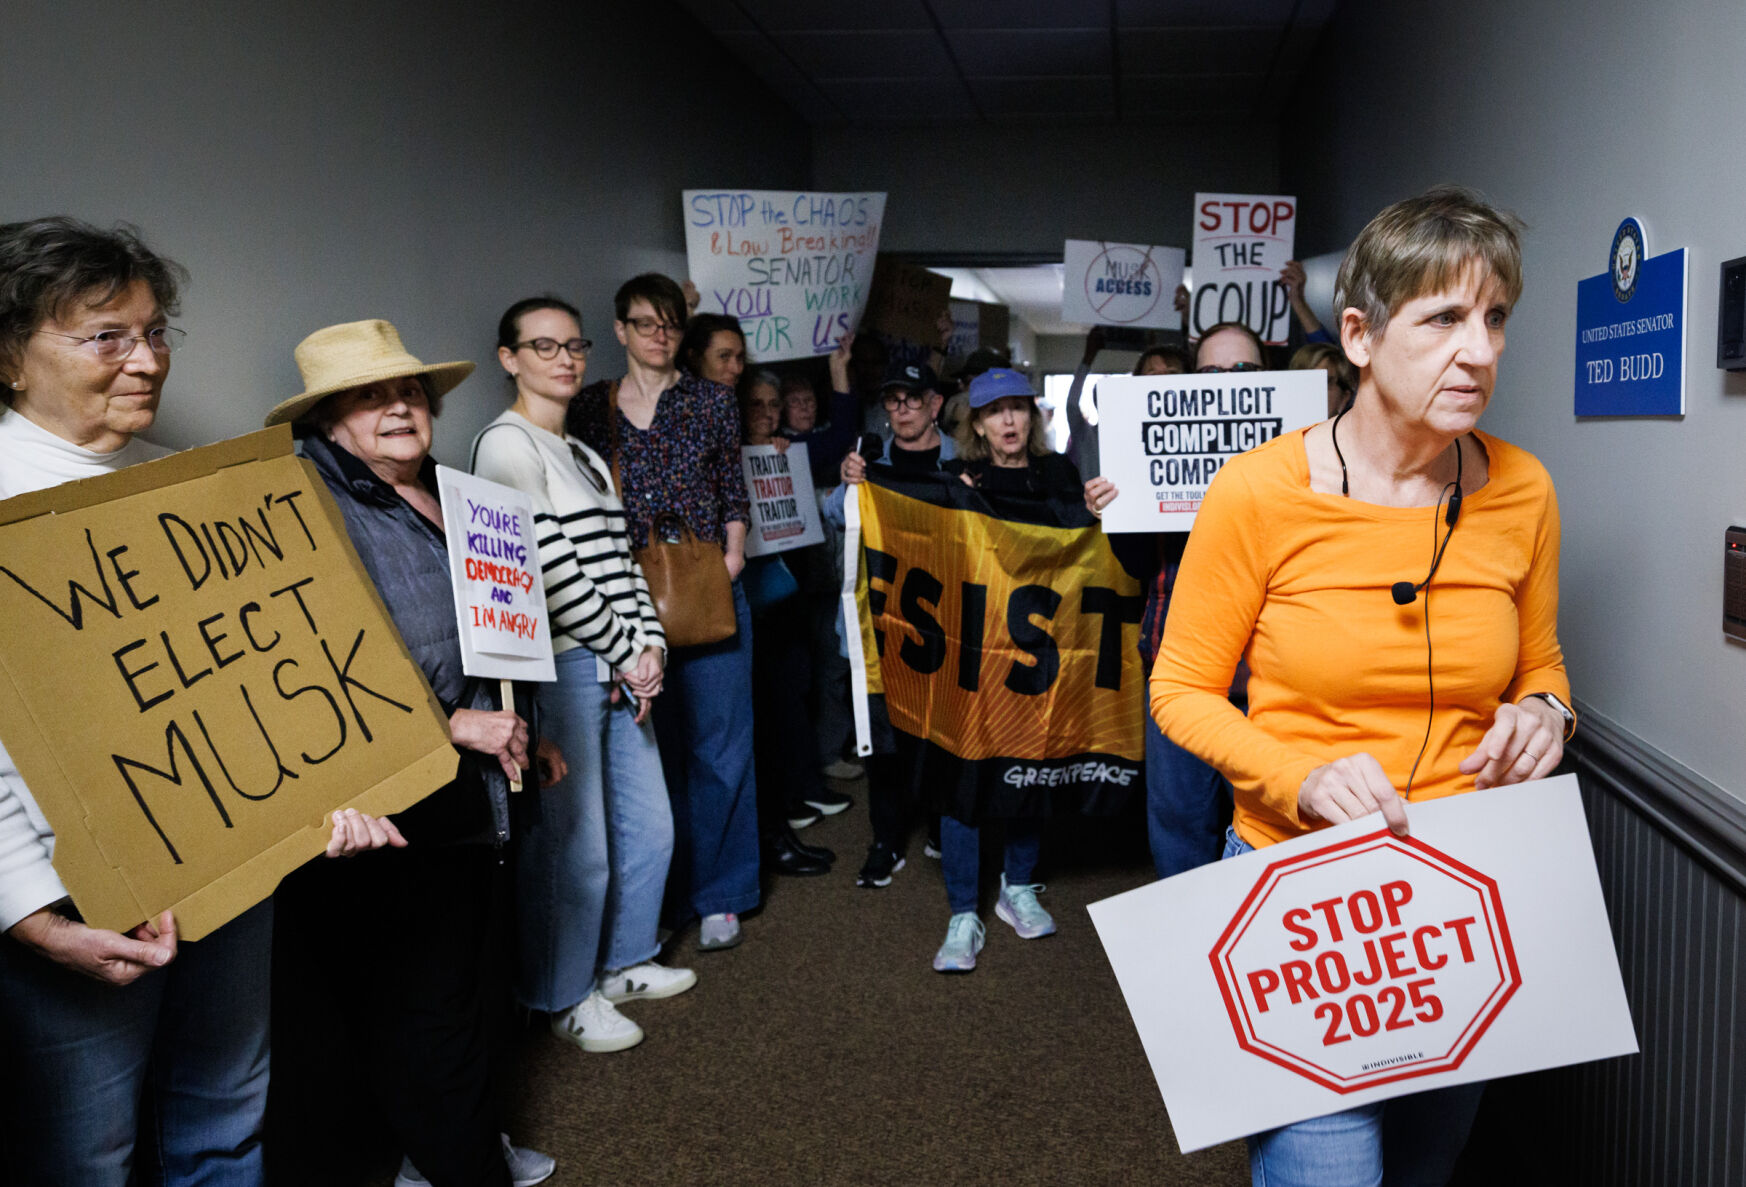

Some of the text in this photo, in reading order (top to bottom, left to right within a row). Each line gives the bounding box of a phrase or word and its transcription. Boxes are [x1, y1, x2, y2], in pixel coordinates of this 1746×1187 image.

[692, 193, 868, 227] STOP the CHAOS
[1200, 201, 1294, 235] STOP
[727, 231, 769, 256] Law
[1214, 242, 1265, 267] THE
[747, 253, 855, 286] SENATOR
[714, 287, 773, 317] YOU
[805, 284, 864, 311] WORK
[1096, 277, 1152, 296] ACCESS
[1193, 280, 1288, 341] COUP
[1582, 313, 1674, 343] UNITED STATES SENATOR
[1586, 352, 1664, 384] TED BUDD
[1147, 387, 1276, 418] COMPLICIT
[1147, 421, 1277, 454] COMPLICIT
[749, 454, 791, 476] TRAITOR
[752, 476, 794, 500] TRAITOR
[1156, 491, 1168, 500] GET
[1171, 491, 1183, 500] THE
[467, 498, 521, 537] YOU'RE
[757, 498, 799, 523] TRAITOR
[0, 490, 317, 630] WE DIDN'T
[467, 531, 527, 567] KILLING
[465, 557, 534, 594] DEMOCRACY
[491, 586, 513, 605] AND
[499, 610, 538, 640] ANGRY
[112, 577, 318, 712] ELECT
[112, 629, 413, 864] MUSK
[1003, 762, 1139, 788] GREENPEACE
[1282, 879, 1413, 951] STOP
[1246, 916, 1476, 1014] PROJECT
[1313, 977, 1444, 1047] 2025
[1369, 1051, 1424, 1069] INDIVISIBLE
